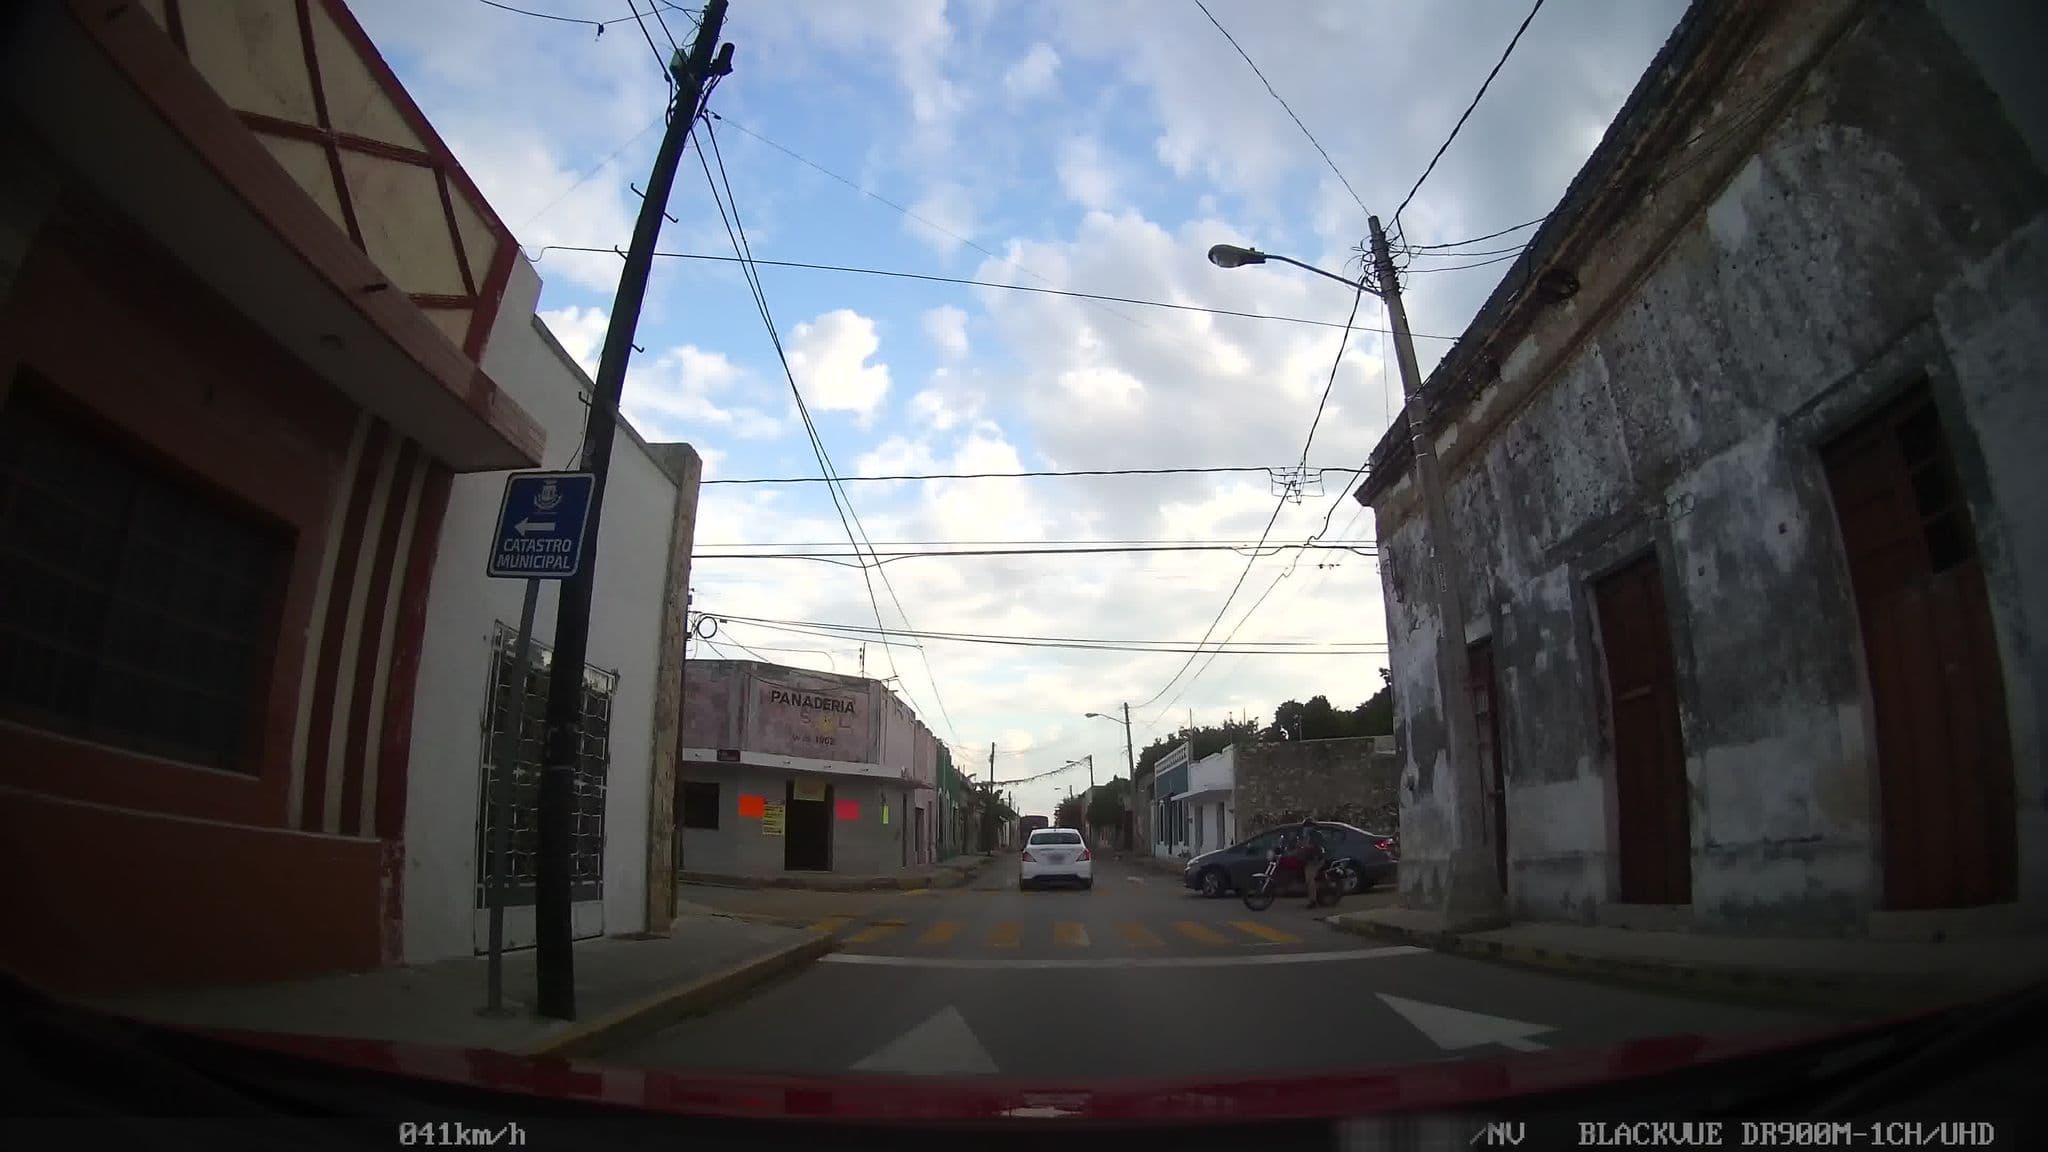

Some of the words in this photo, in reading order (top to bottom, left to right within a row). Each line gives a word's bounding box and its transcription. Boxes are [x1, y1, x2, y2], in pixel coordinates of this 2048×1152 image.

[503, 538, 572, 553] CATASTRO
[497, 553, 571, 569] MUNICIPAL
[770, 690, 856, 714] PANADERIA
